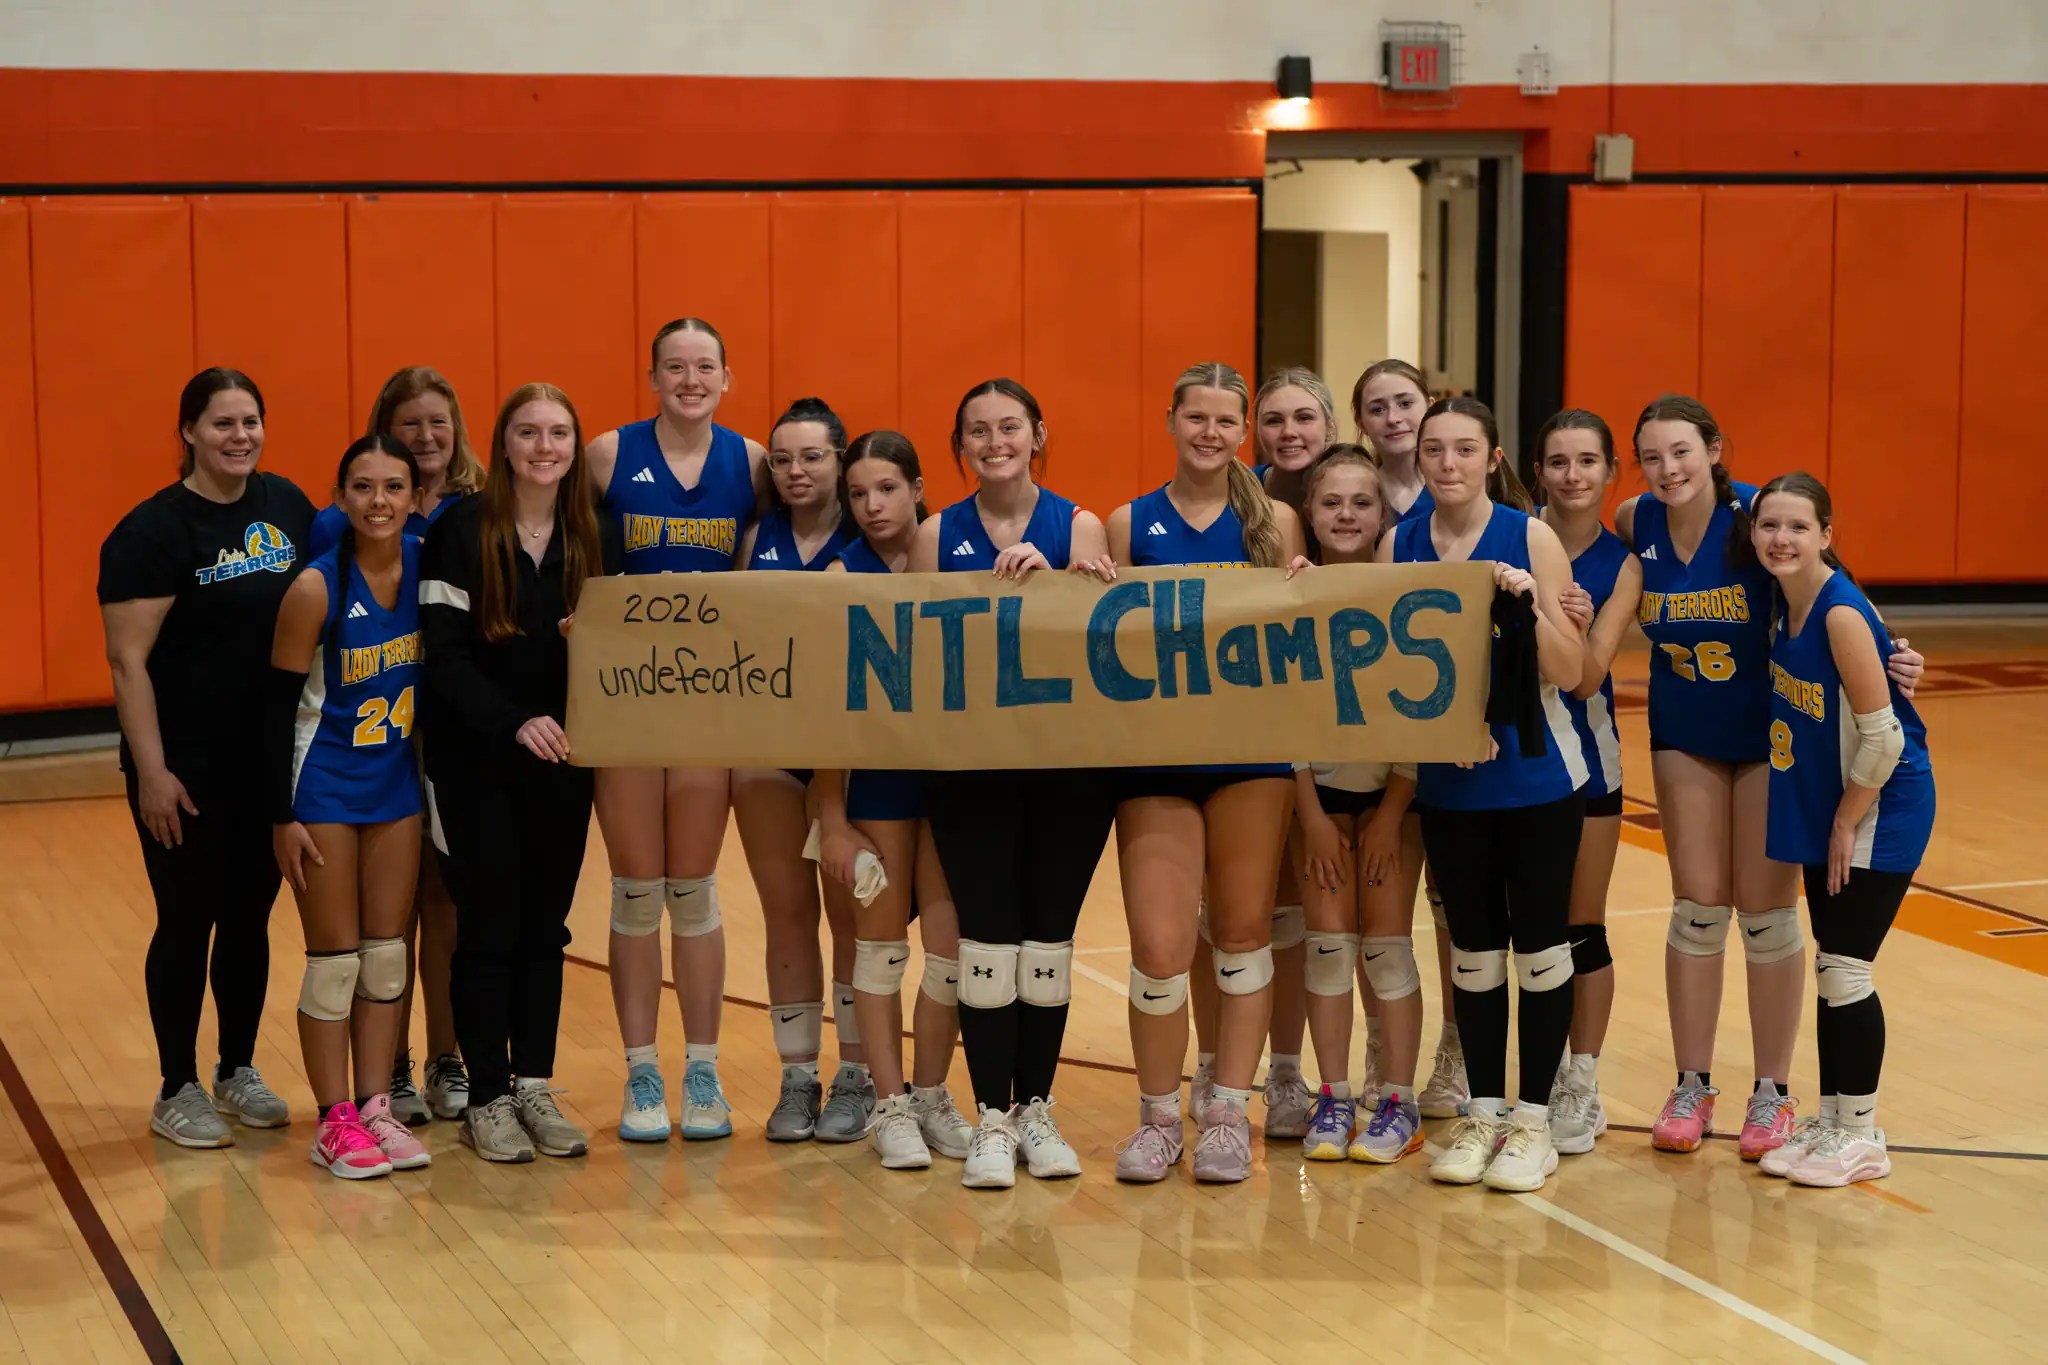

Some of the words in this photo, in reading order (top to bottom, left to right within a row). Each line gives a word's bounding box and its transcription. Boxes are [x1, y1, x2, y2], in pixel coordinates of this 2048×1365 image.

[1401, 47, 1439, 86] EXIT
[623, 512, 664, 553] LADY
[665, 517, 736, 556] TERRORS
[195, 545, 296, 585] TERRORS
[623, 593, 720, 624] 2026
[1666, 584, 1749, 623] TERRORS
[341, 644, 381, 687] LADY
[599, 637, 793, 698] undefeated
[845, 596, 1073, 713] NTL
[1659, 641, 1737, 682] 26
[352, 685, 415, 747] 24
